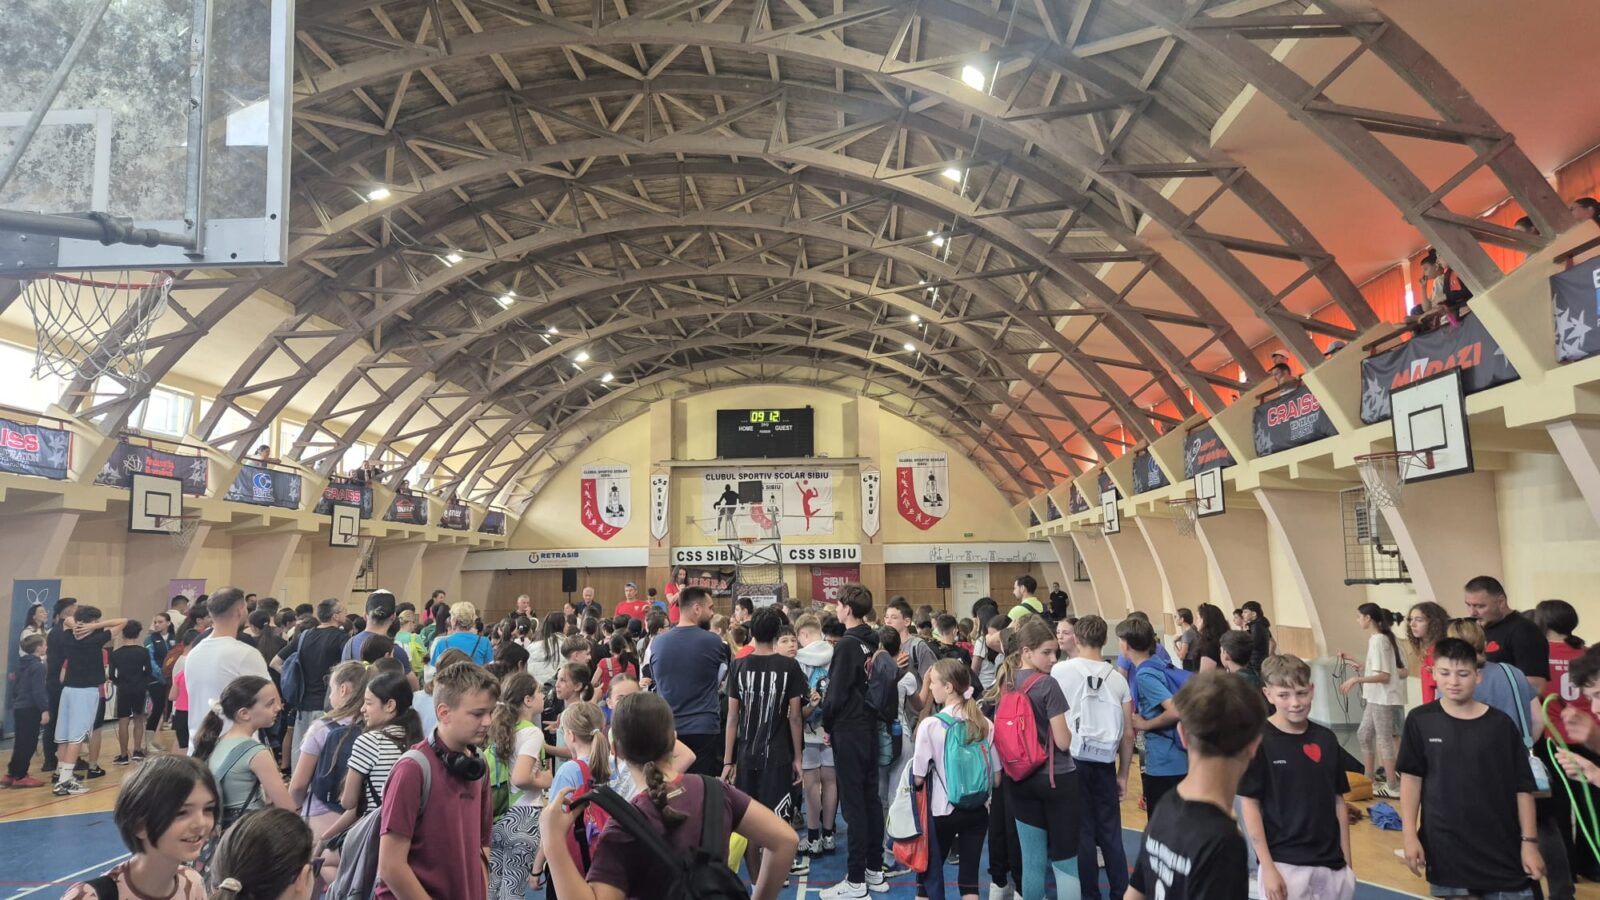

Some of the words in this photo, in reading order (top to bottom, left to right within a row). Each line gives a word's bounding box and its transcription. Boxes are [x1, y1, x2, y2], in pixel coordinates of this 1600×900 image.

[0, 428, 40, 452] ISS
[807, 471, 829, 479] SIBIU
[677, 551, 702, 562] CSS
[789, 549, 815, 560] CSS
[819, 548, 857, 560] SIBIU
[823, 576, 848, 587] SIBIU
